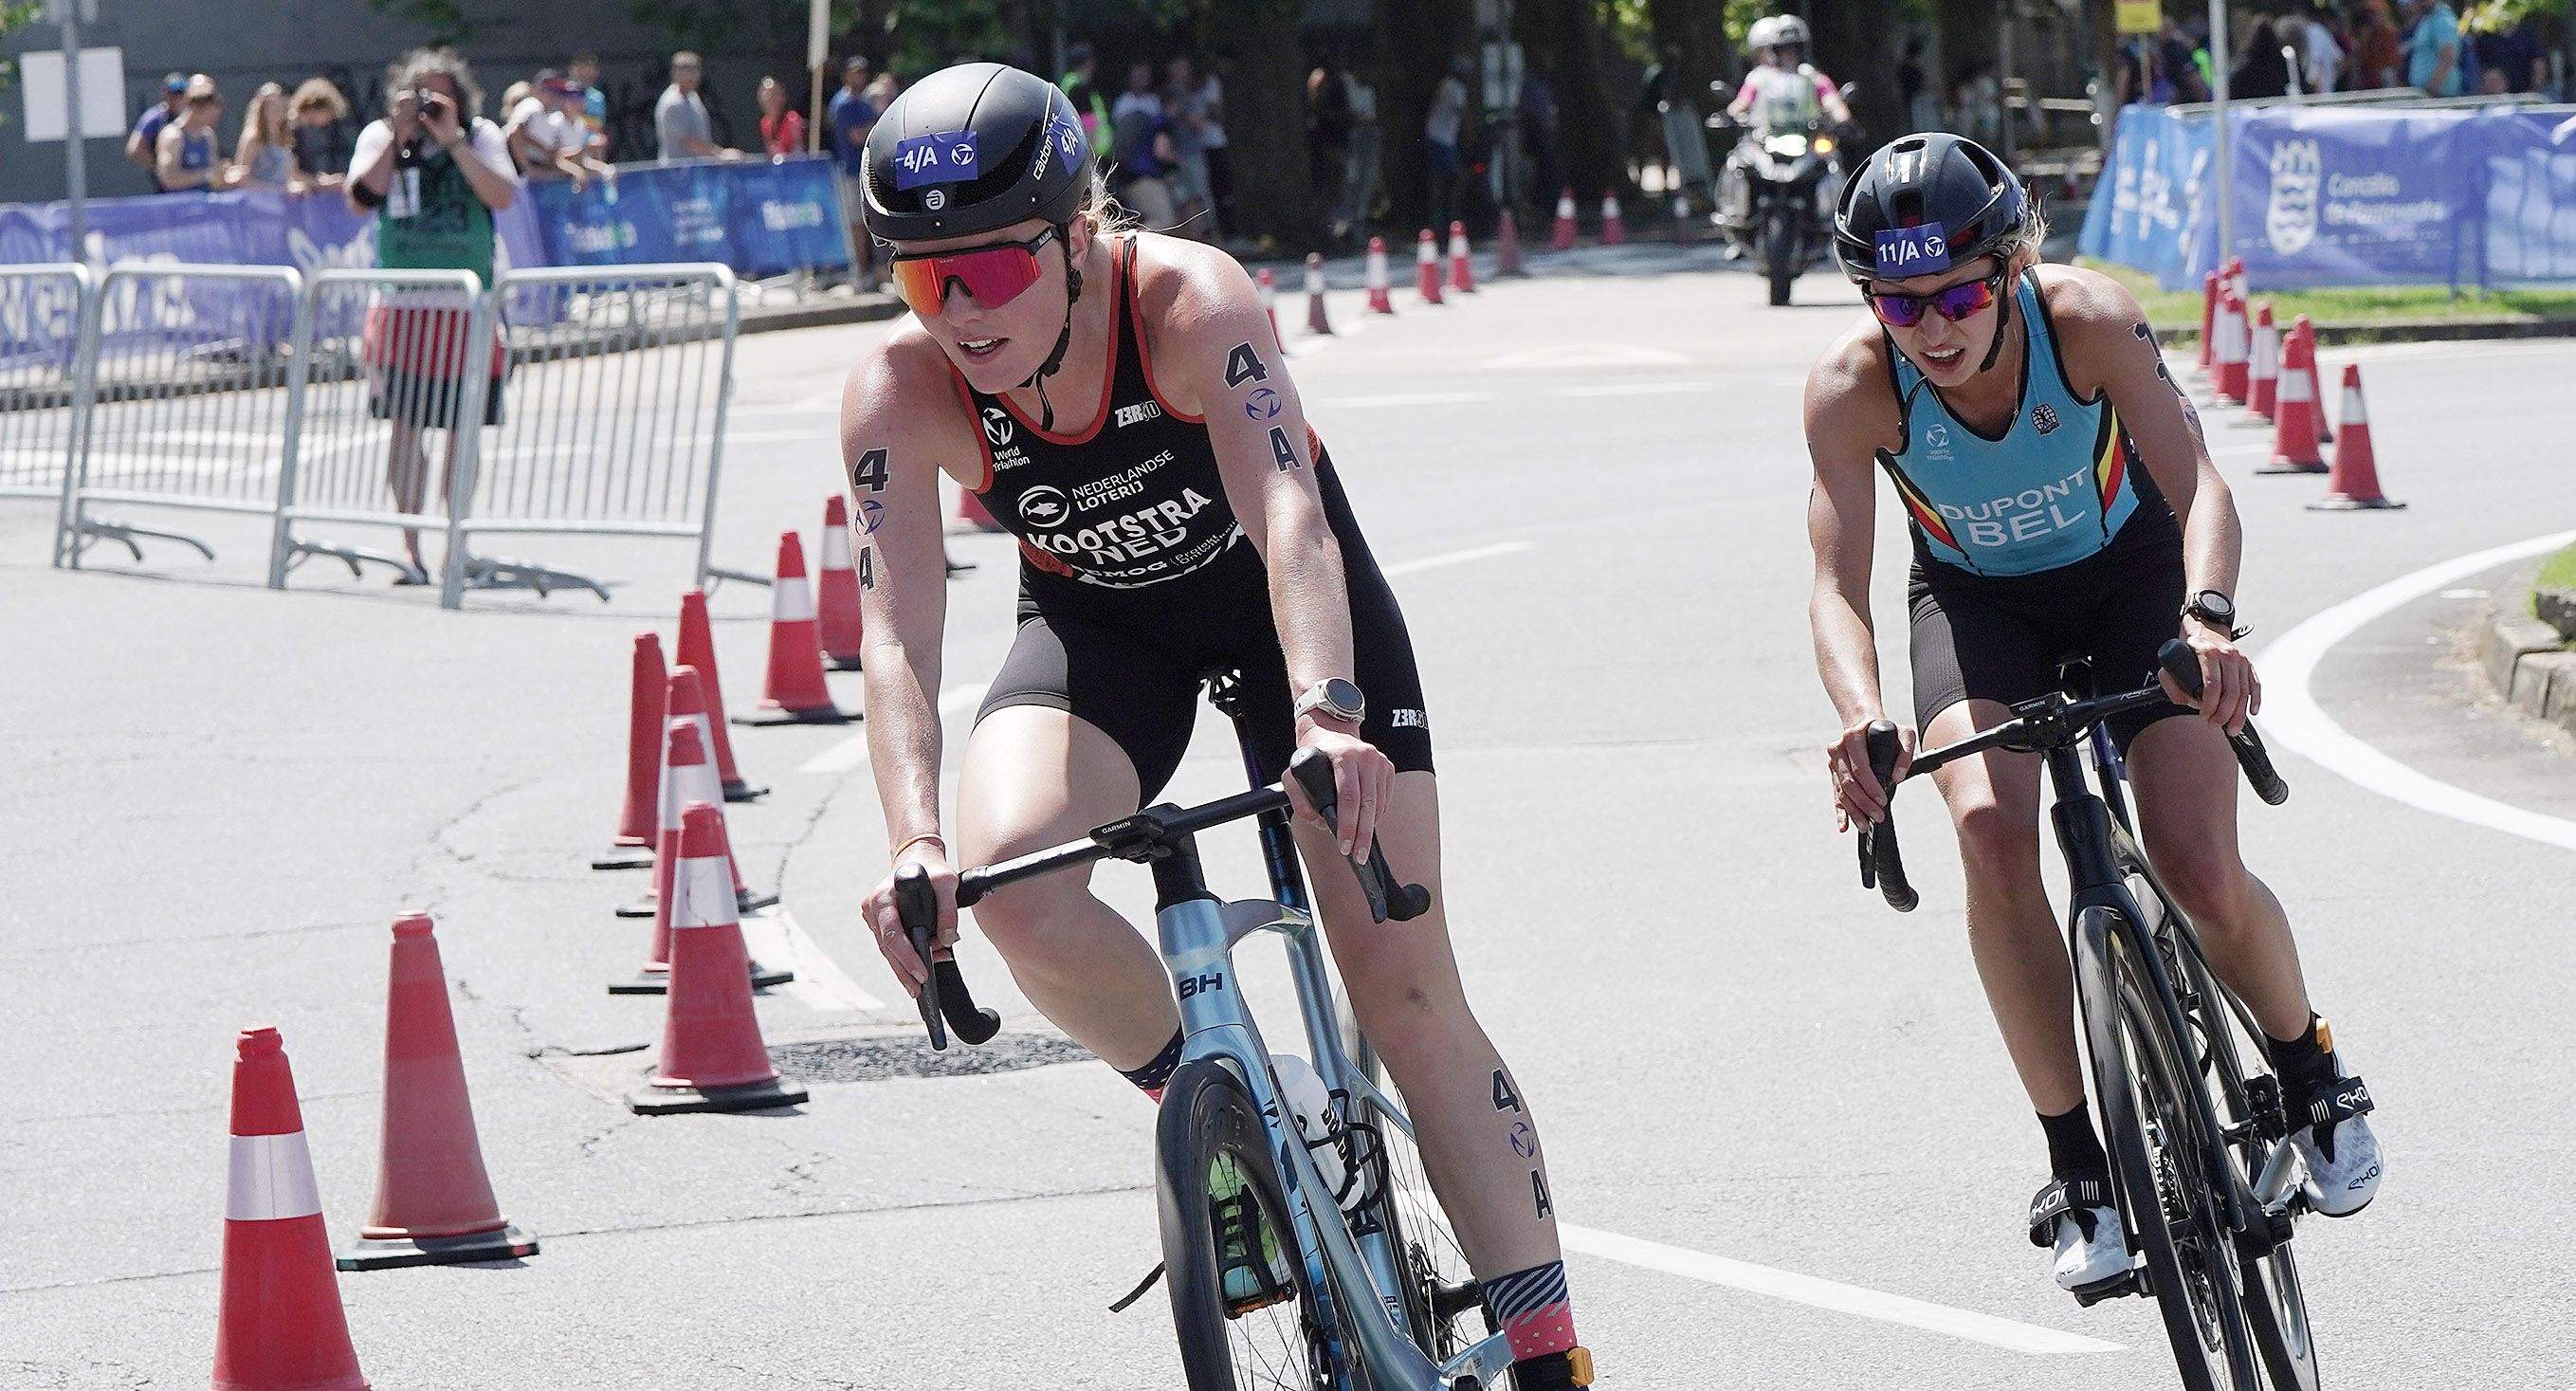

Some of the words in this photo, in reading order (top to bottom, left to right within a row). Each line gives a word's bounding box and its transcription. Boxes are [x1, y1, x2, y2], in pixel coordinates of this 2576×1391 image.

[904, 145, 939, 174] 4/A
[1878, 239, 1921, 266] 11/A
[1223, 340, 1269, 390] 4
[853, 447, 890, 494] 4
[994, 445, 1020, 461] World
[1267, 425, 1304, 473] A
[1071, 449, 1175, 500] NEDERLANDSE
[1076, 480, 1145, 513] LOTERIJ
[1938, 466, 2088, 522] DUPONT
[1027, 486, 1213, 555] KOOTSTRA
[1967, 503, 2087, 548] BEL
[859, 544, 875, 592] A
[1091, 526, 1187, 565] NED
[1102, 820, 1131, 834] GARMIN
[1178, 971, 1223, 1002] BH
[1490, 1068, 1522, 1114] 4
[1529, 1168, 1553, 1220] A
